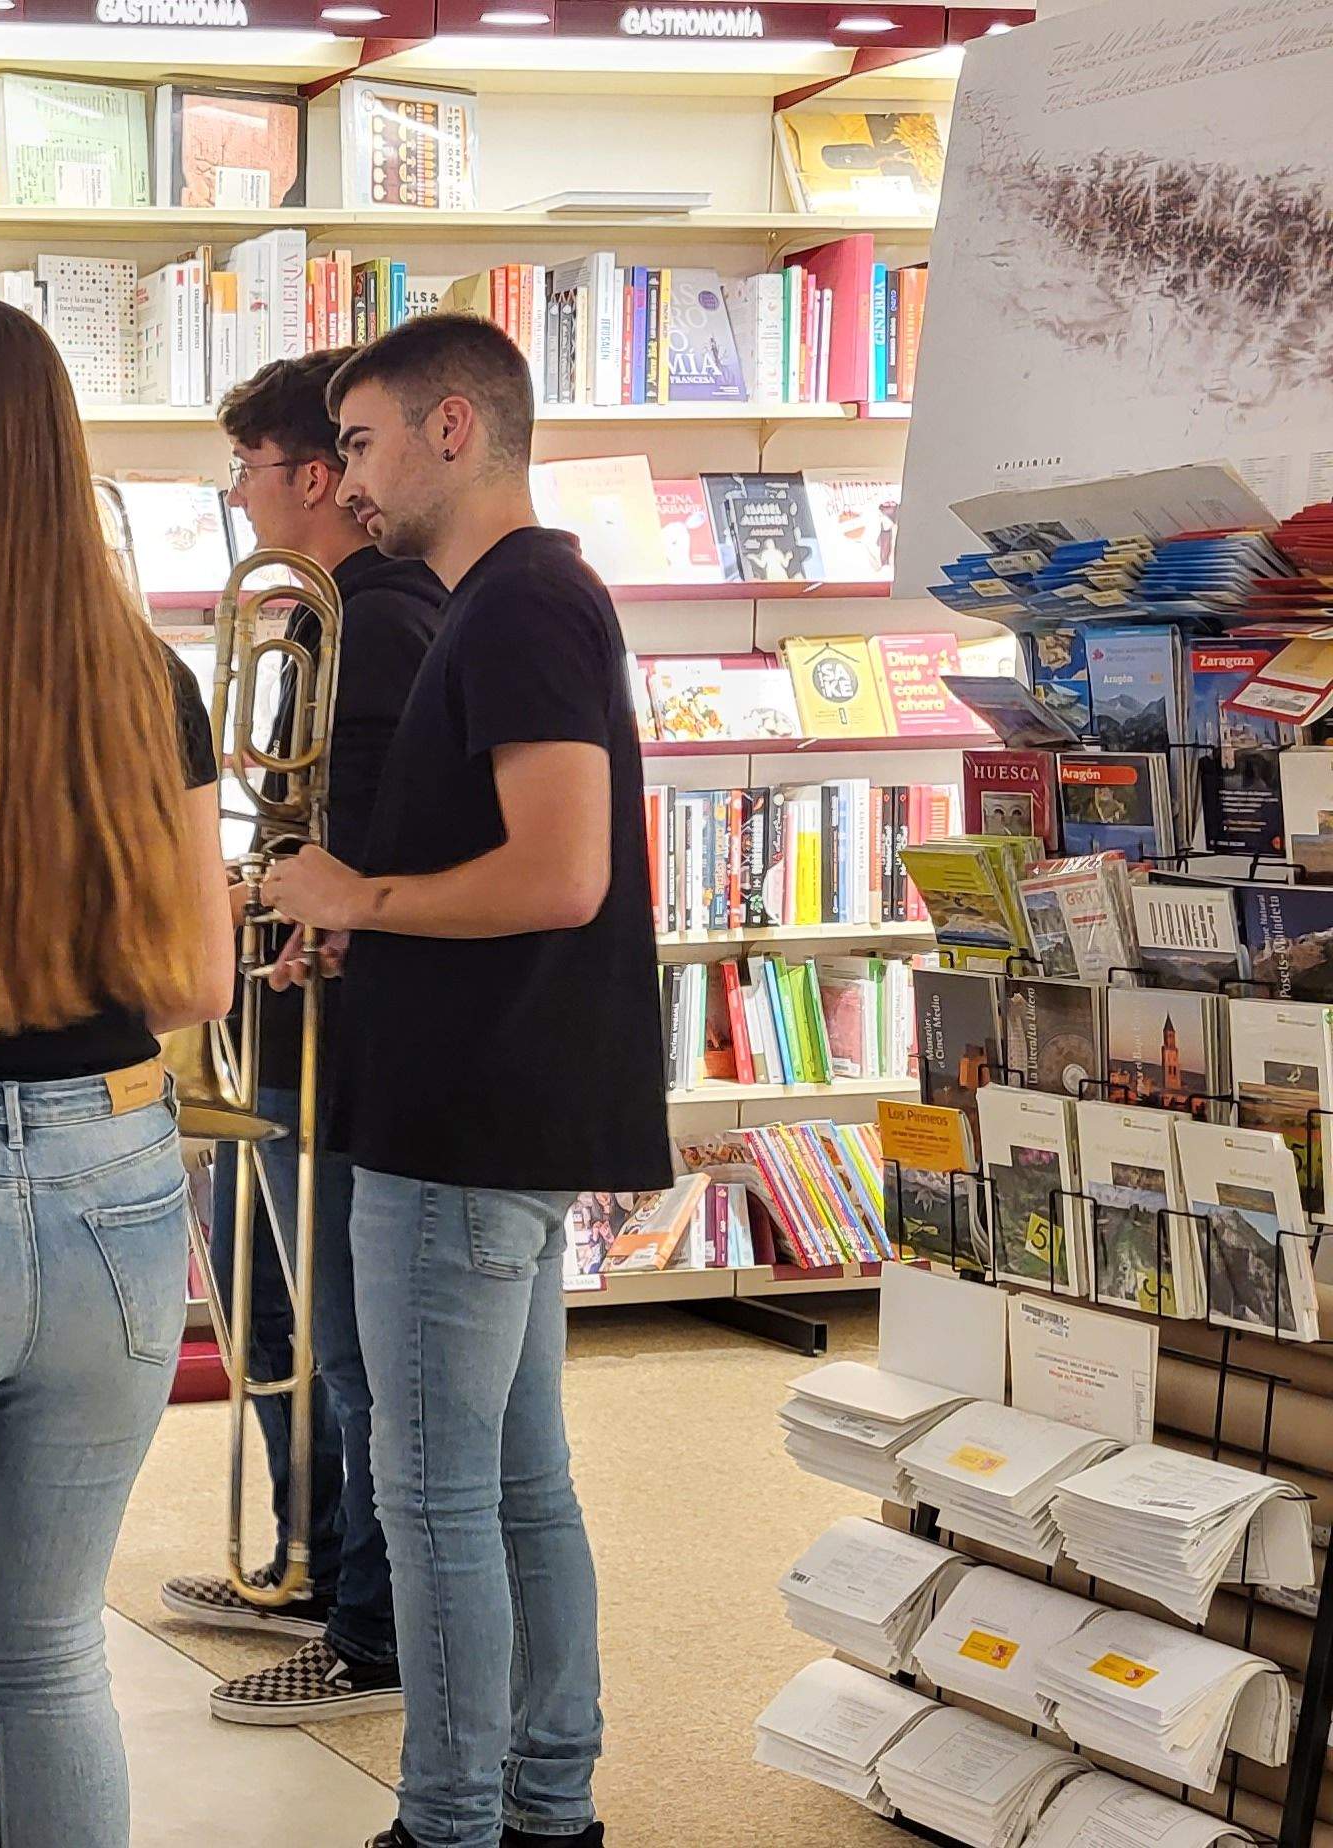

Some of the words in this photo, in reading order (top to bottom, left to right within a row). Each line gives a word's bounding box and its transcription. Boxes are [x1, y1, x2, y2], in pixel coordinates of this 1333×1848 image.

[620, 6, 764, 38] GASTRONOMÍA
[430, 293, 439, 303] &
[873, 281, 885, 345] GINEBRA
[886, 651, 929, 667] Dime
[1200, 655, 1254, 668] Zaragoza
[890, 668, 922, 684] qué
[1103, 674, 1134, 685] Aragón
[893, 684, 937, 697] como
[897, 698, 945, 712] ahora
[973, 765, 1040, 781] HUESCA
[1062, 768, 1101, 781] Aragón
[1257, 895, 1265, 926] Natural
[933, 994, 941, 1028] Medio
[925, 1019, 933, 1061] Monzón
[936, 1030, 945, 1060] Cinca
[888, 1108, 905, 1120] Los
[1031, 1223, 1048, 1250] 5
